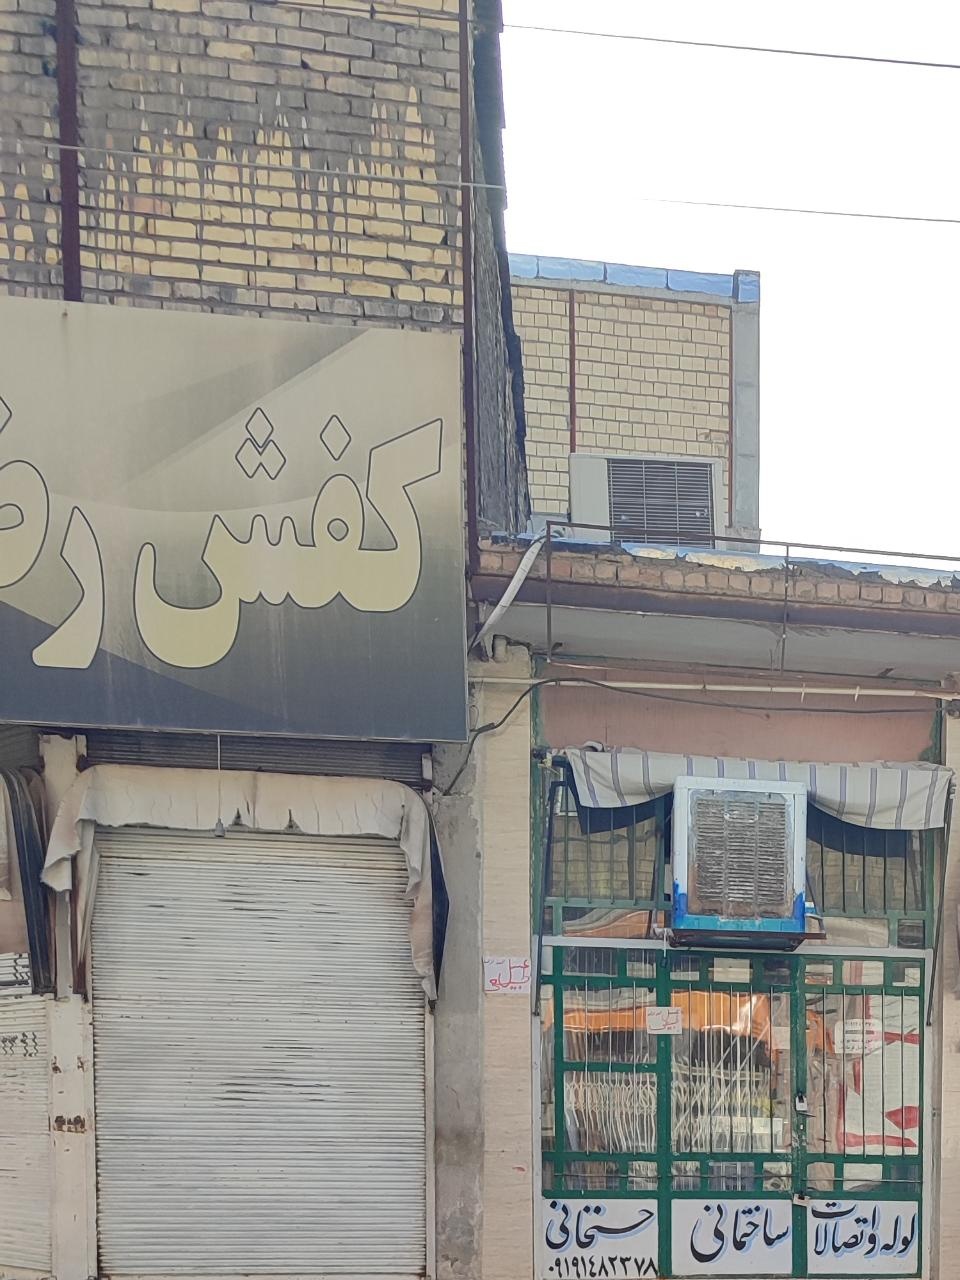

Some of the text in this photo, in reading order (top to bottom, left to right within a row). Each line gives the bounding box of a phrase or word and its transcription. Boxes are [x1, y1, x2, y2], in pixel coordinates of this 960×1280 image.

[134, 407, 443, 669] کفش
[690, 1203, 789, 1263] ساختمانی
[880, 1213, 917, 1254] لوله
